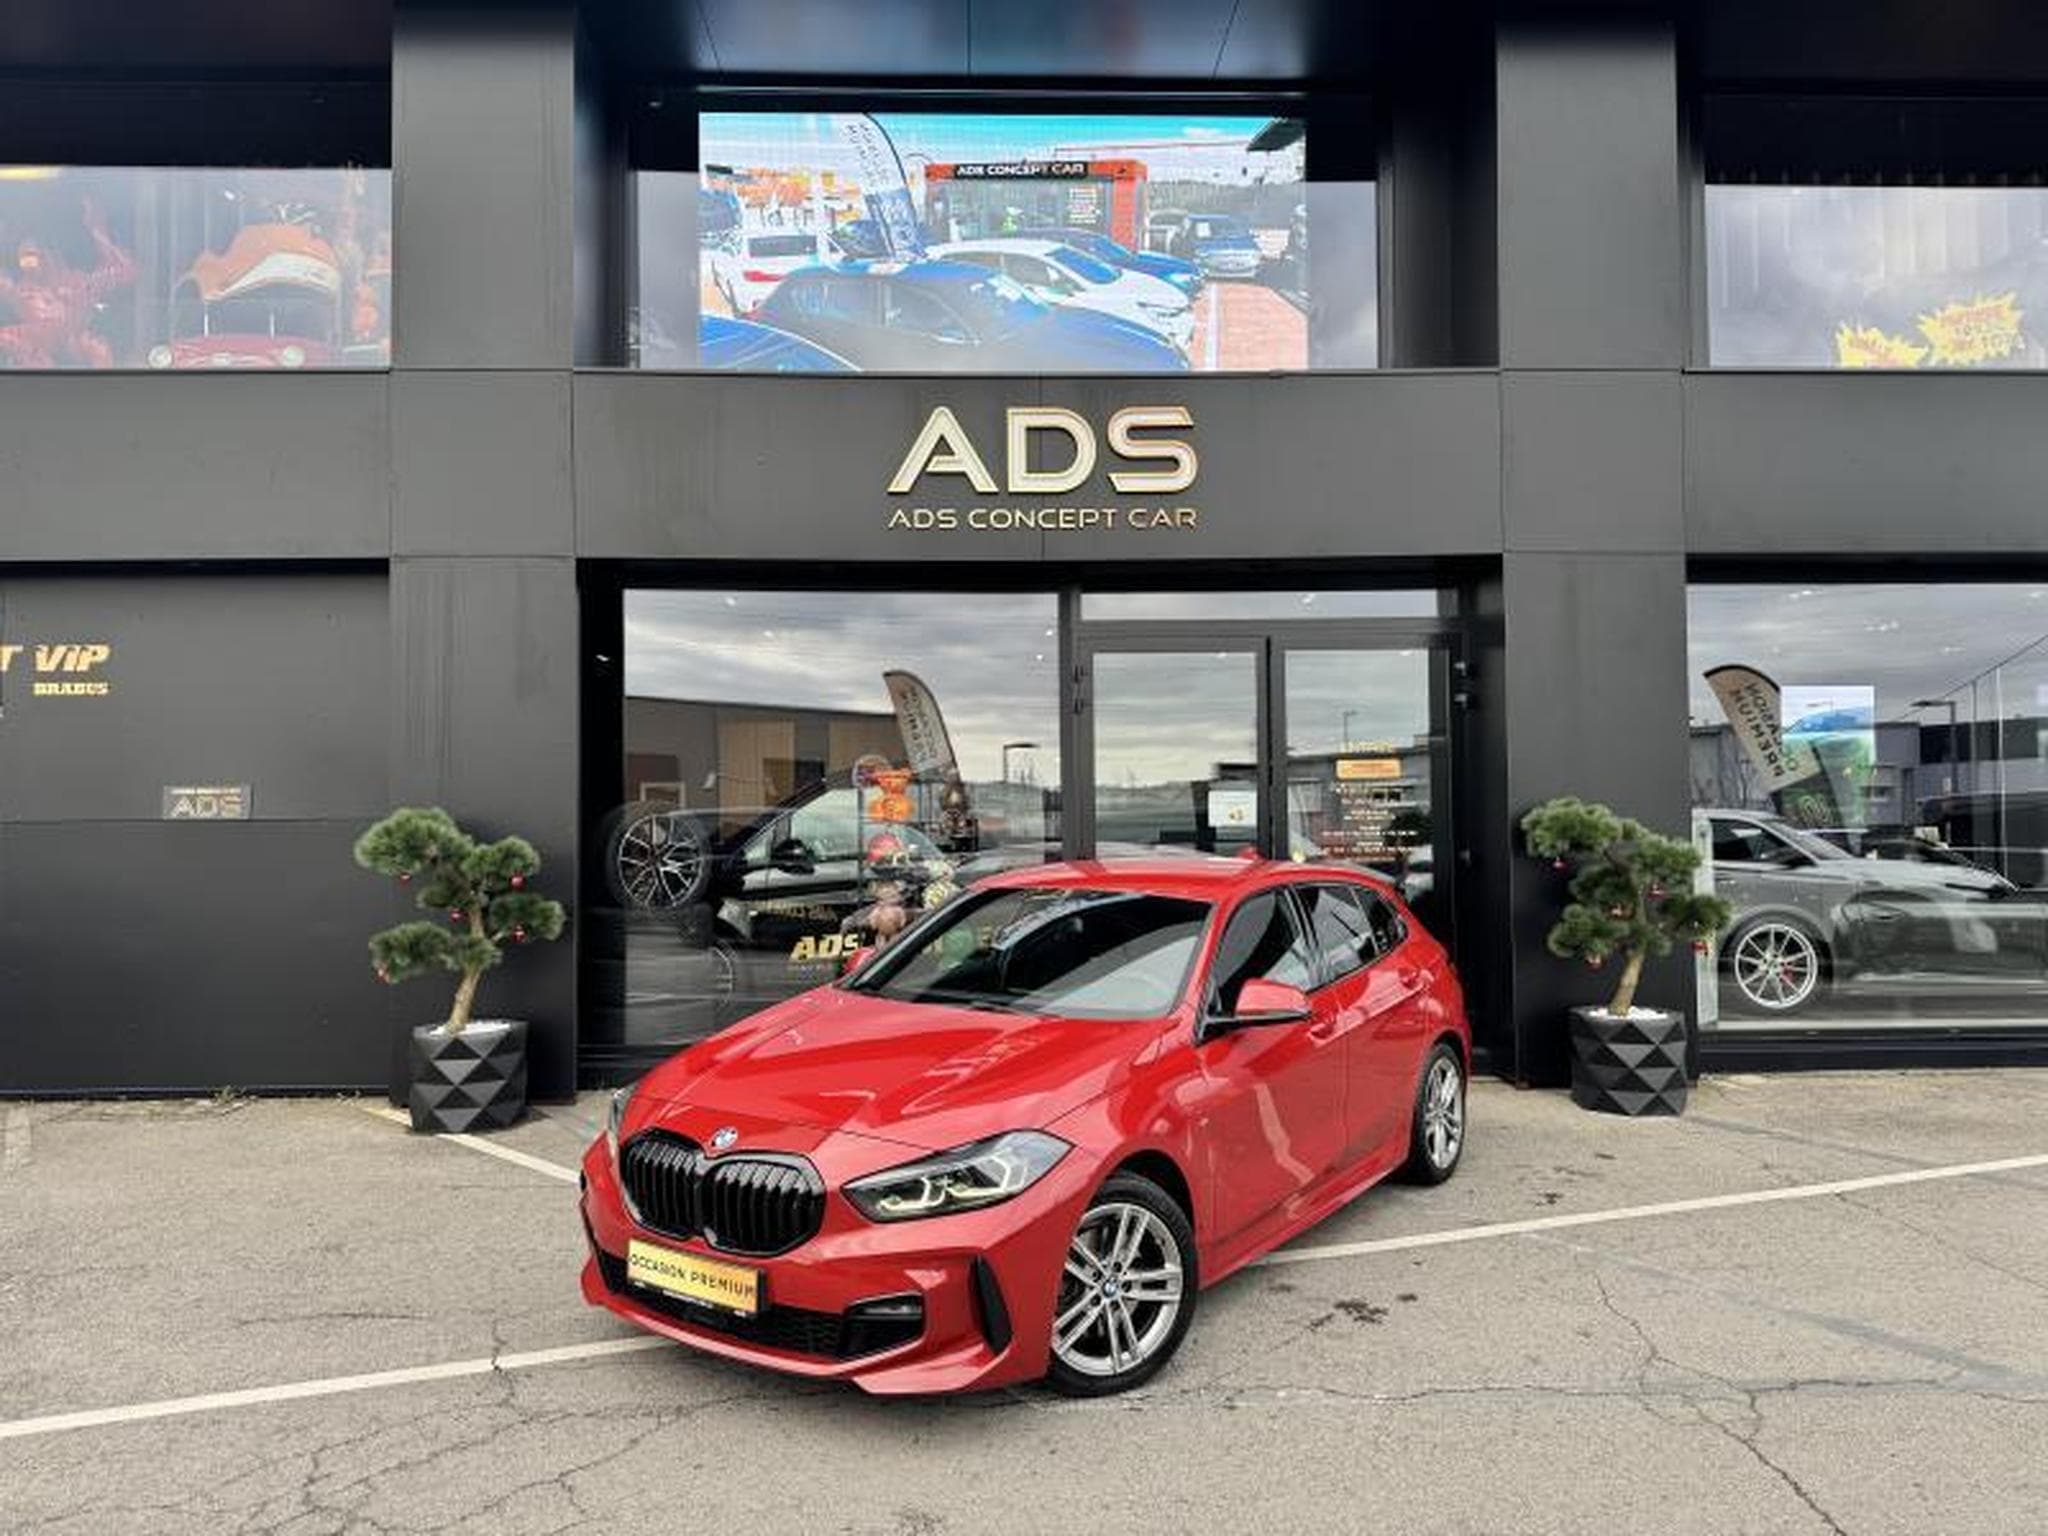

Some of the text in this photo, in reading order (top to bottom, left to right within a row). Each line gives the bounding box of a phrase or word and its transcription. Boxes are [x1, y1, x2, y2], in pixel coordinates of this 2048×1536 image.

[887, 406, 1198, 493] ADS
[888, 508, 1198, 530] ADS CONCEPT CAR
[789, 933, 859, 963] ADS
[629, 1253, 756, 1299] OCCASION PREMIUM
